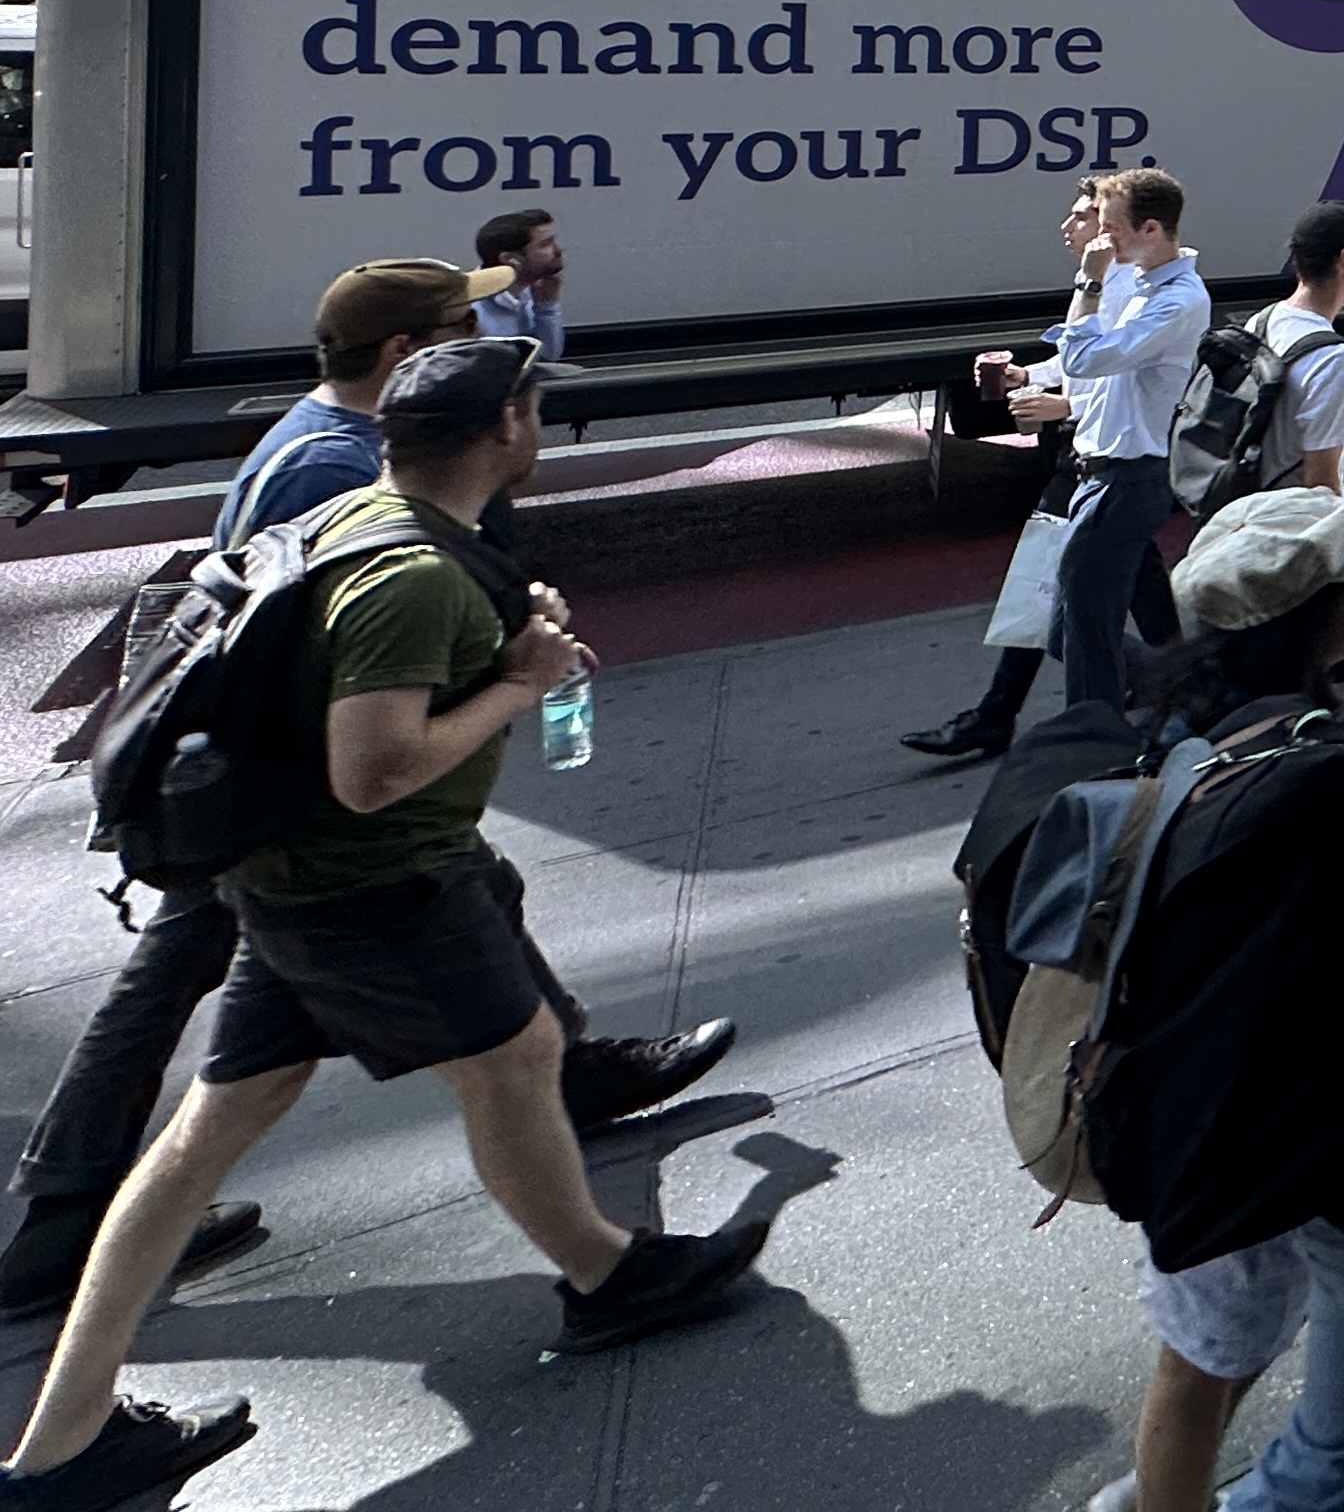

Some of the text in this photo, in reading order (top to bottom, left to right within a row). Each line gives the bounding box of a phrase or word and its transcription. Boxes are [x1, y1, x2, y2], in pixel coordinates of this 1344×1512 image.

[852, 24, 1103, 75] more
[299, 107, 1157, 201] from your DSP.
